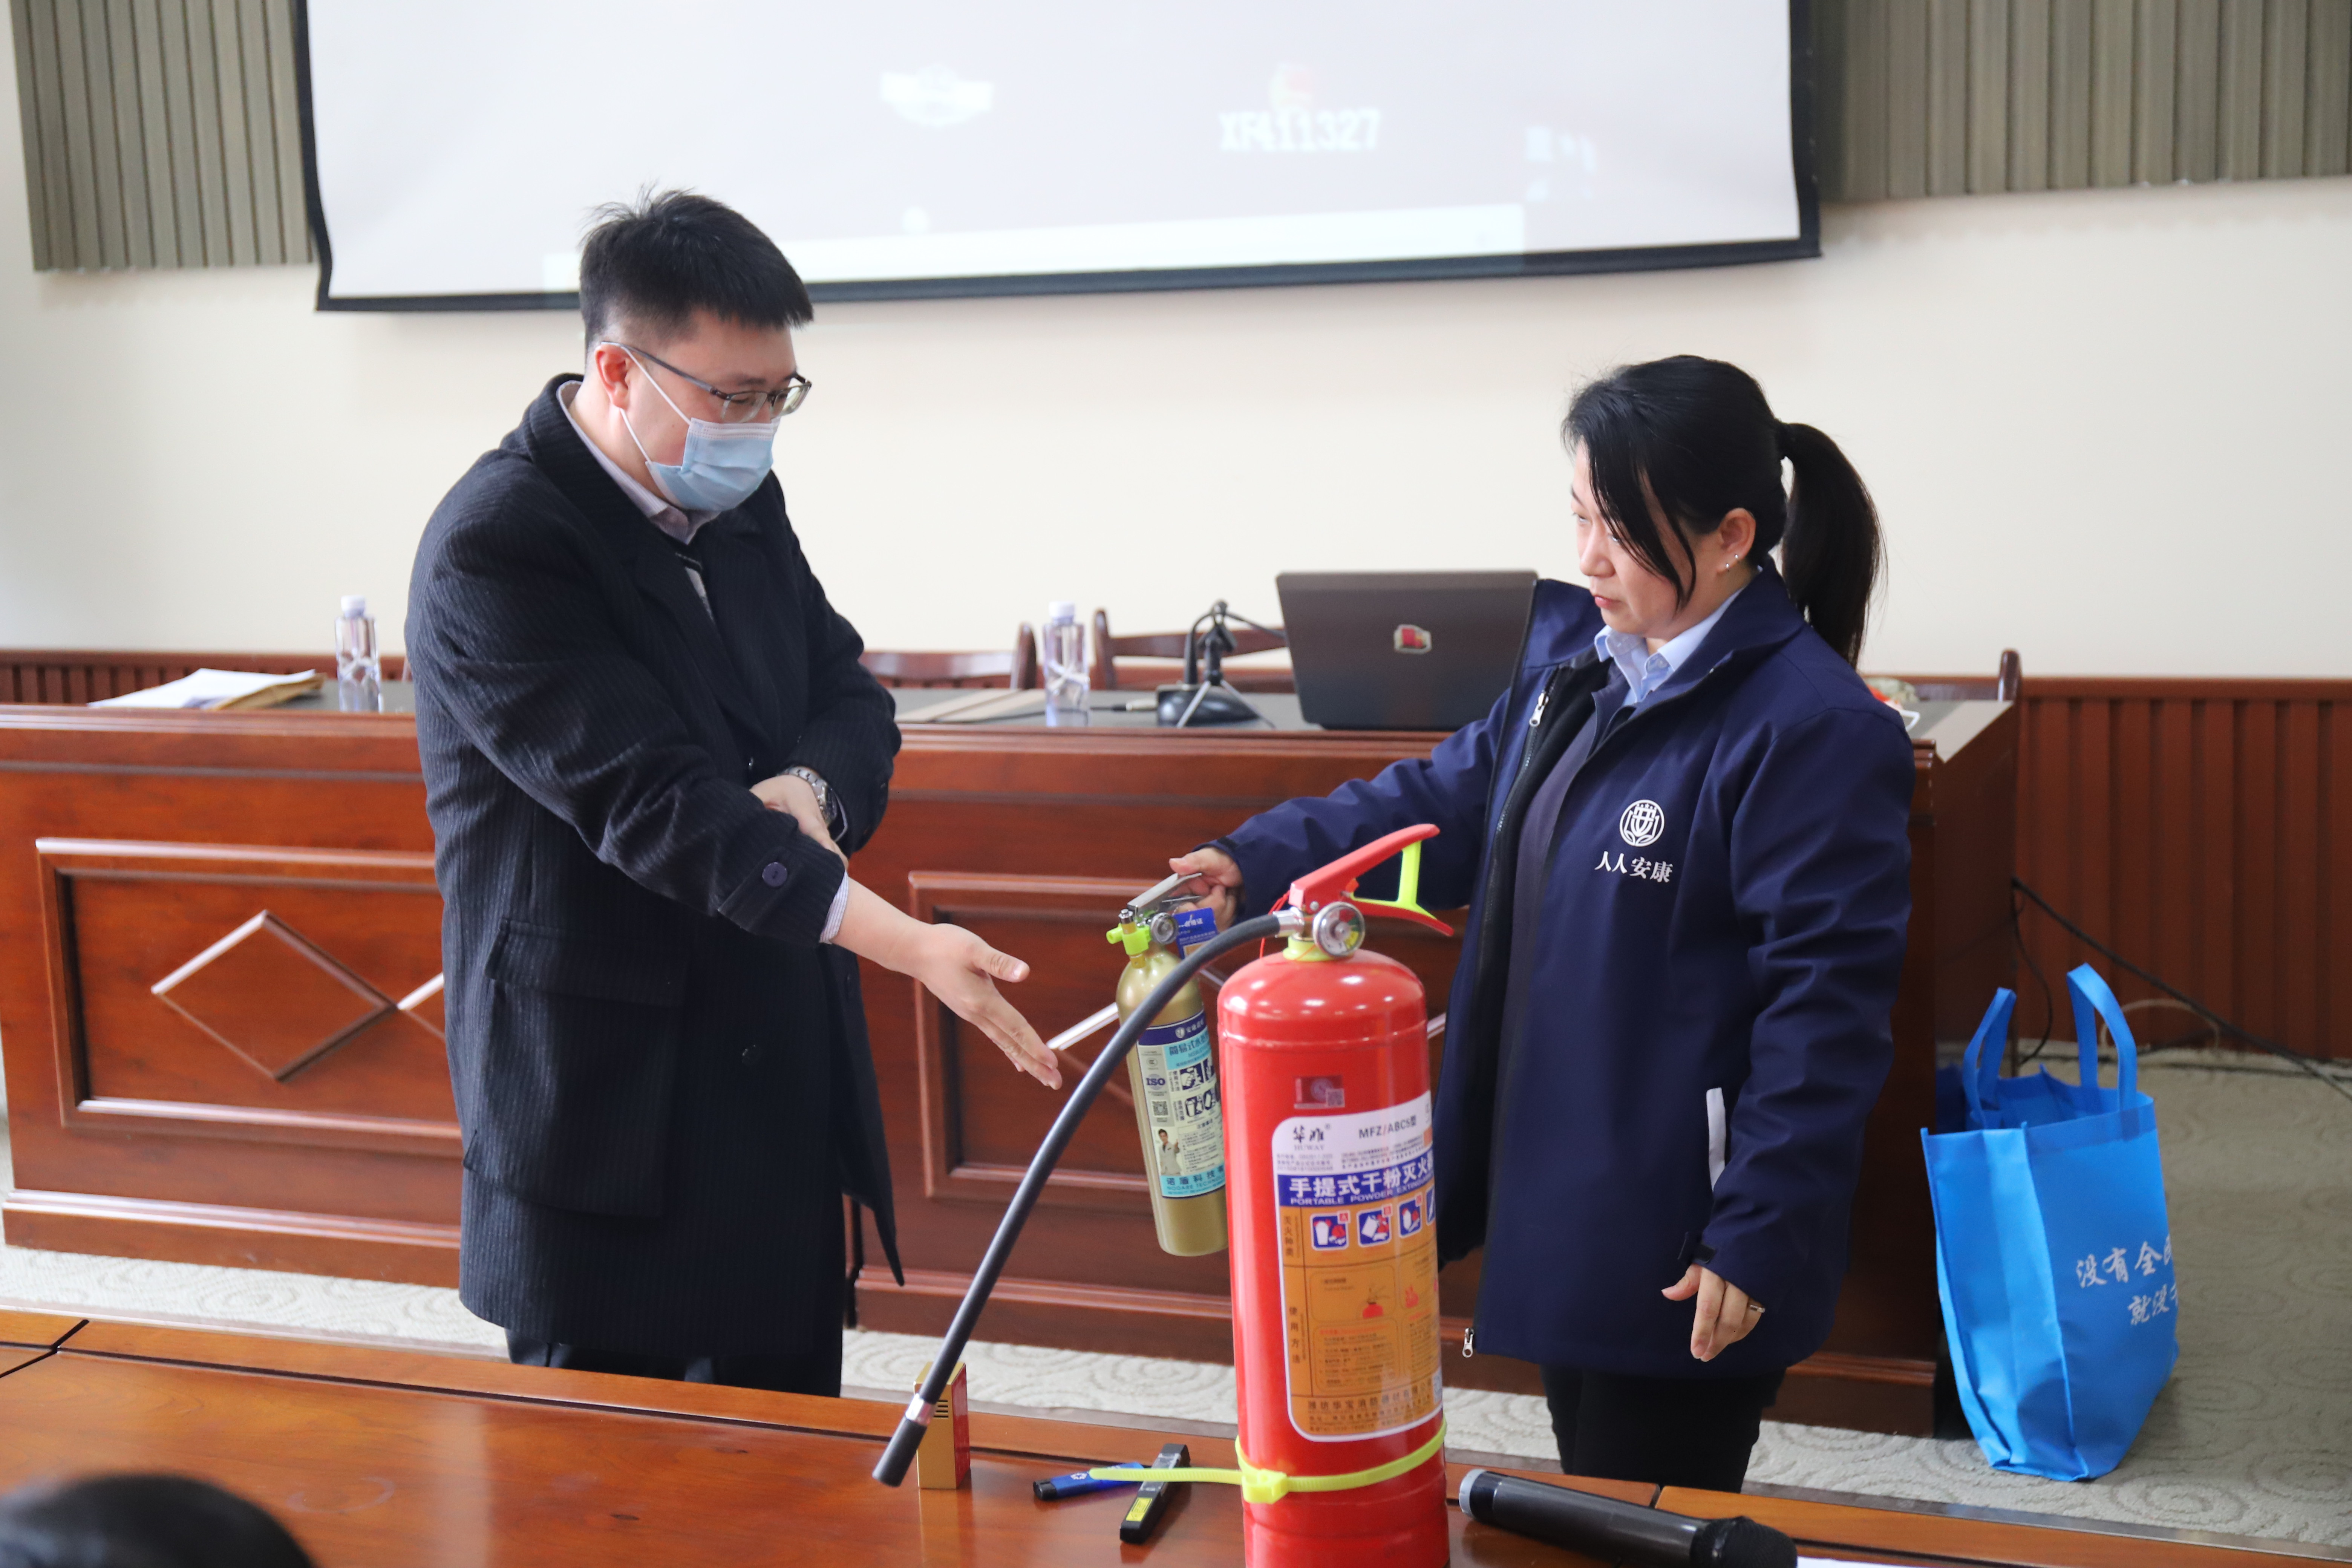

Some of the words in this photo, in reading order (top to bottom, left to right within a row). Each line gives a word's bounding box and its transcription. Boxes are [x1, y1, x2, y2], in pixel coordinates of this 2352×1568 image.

[1594, 850, 1673, 883] 人人安康
[1146, 1078, 1165, 1086] ISO
[1290, 1196, 1344, 1205] PORTABLE
[1351, 1188, 1393, 1203] POWDER
